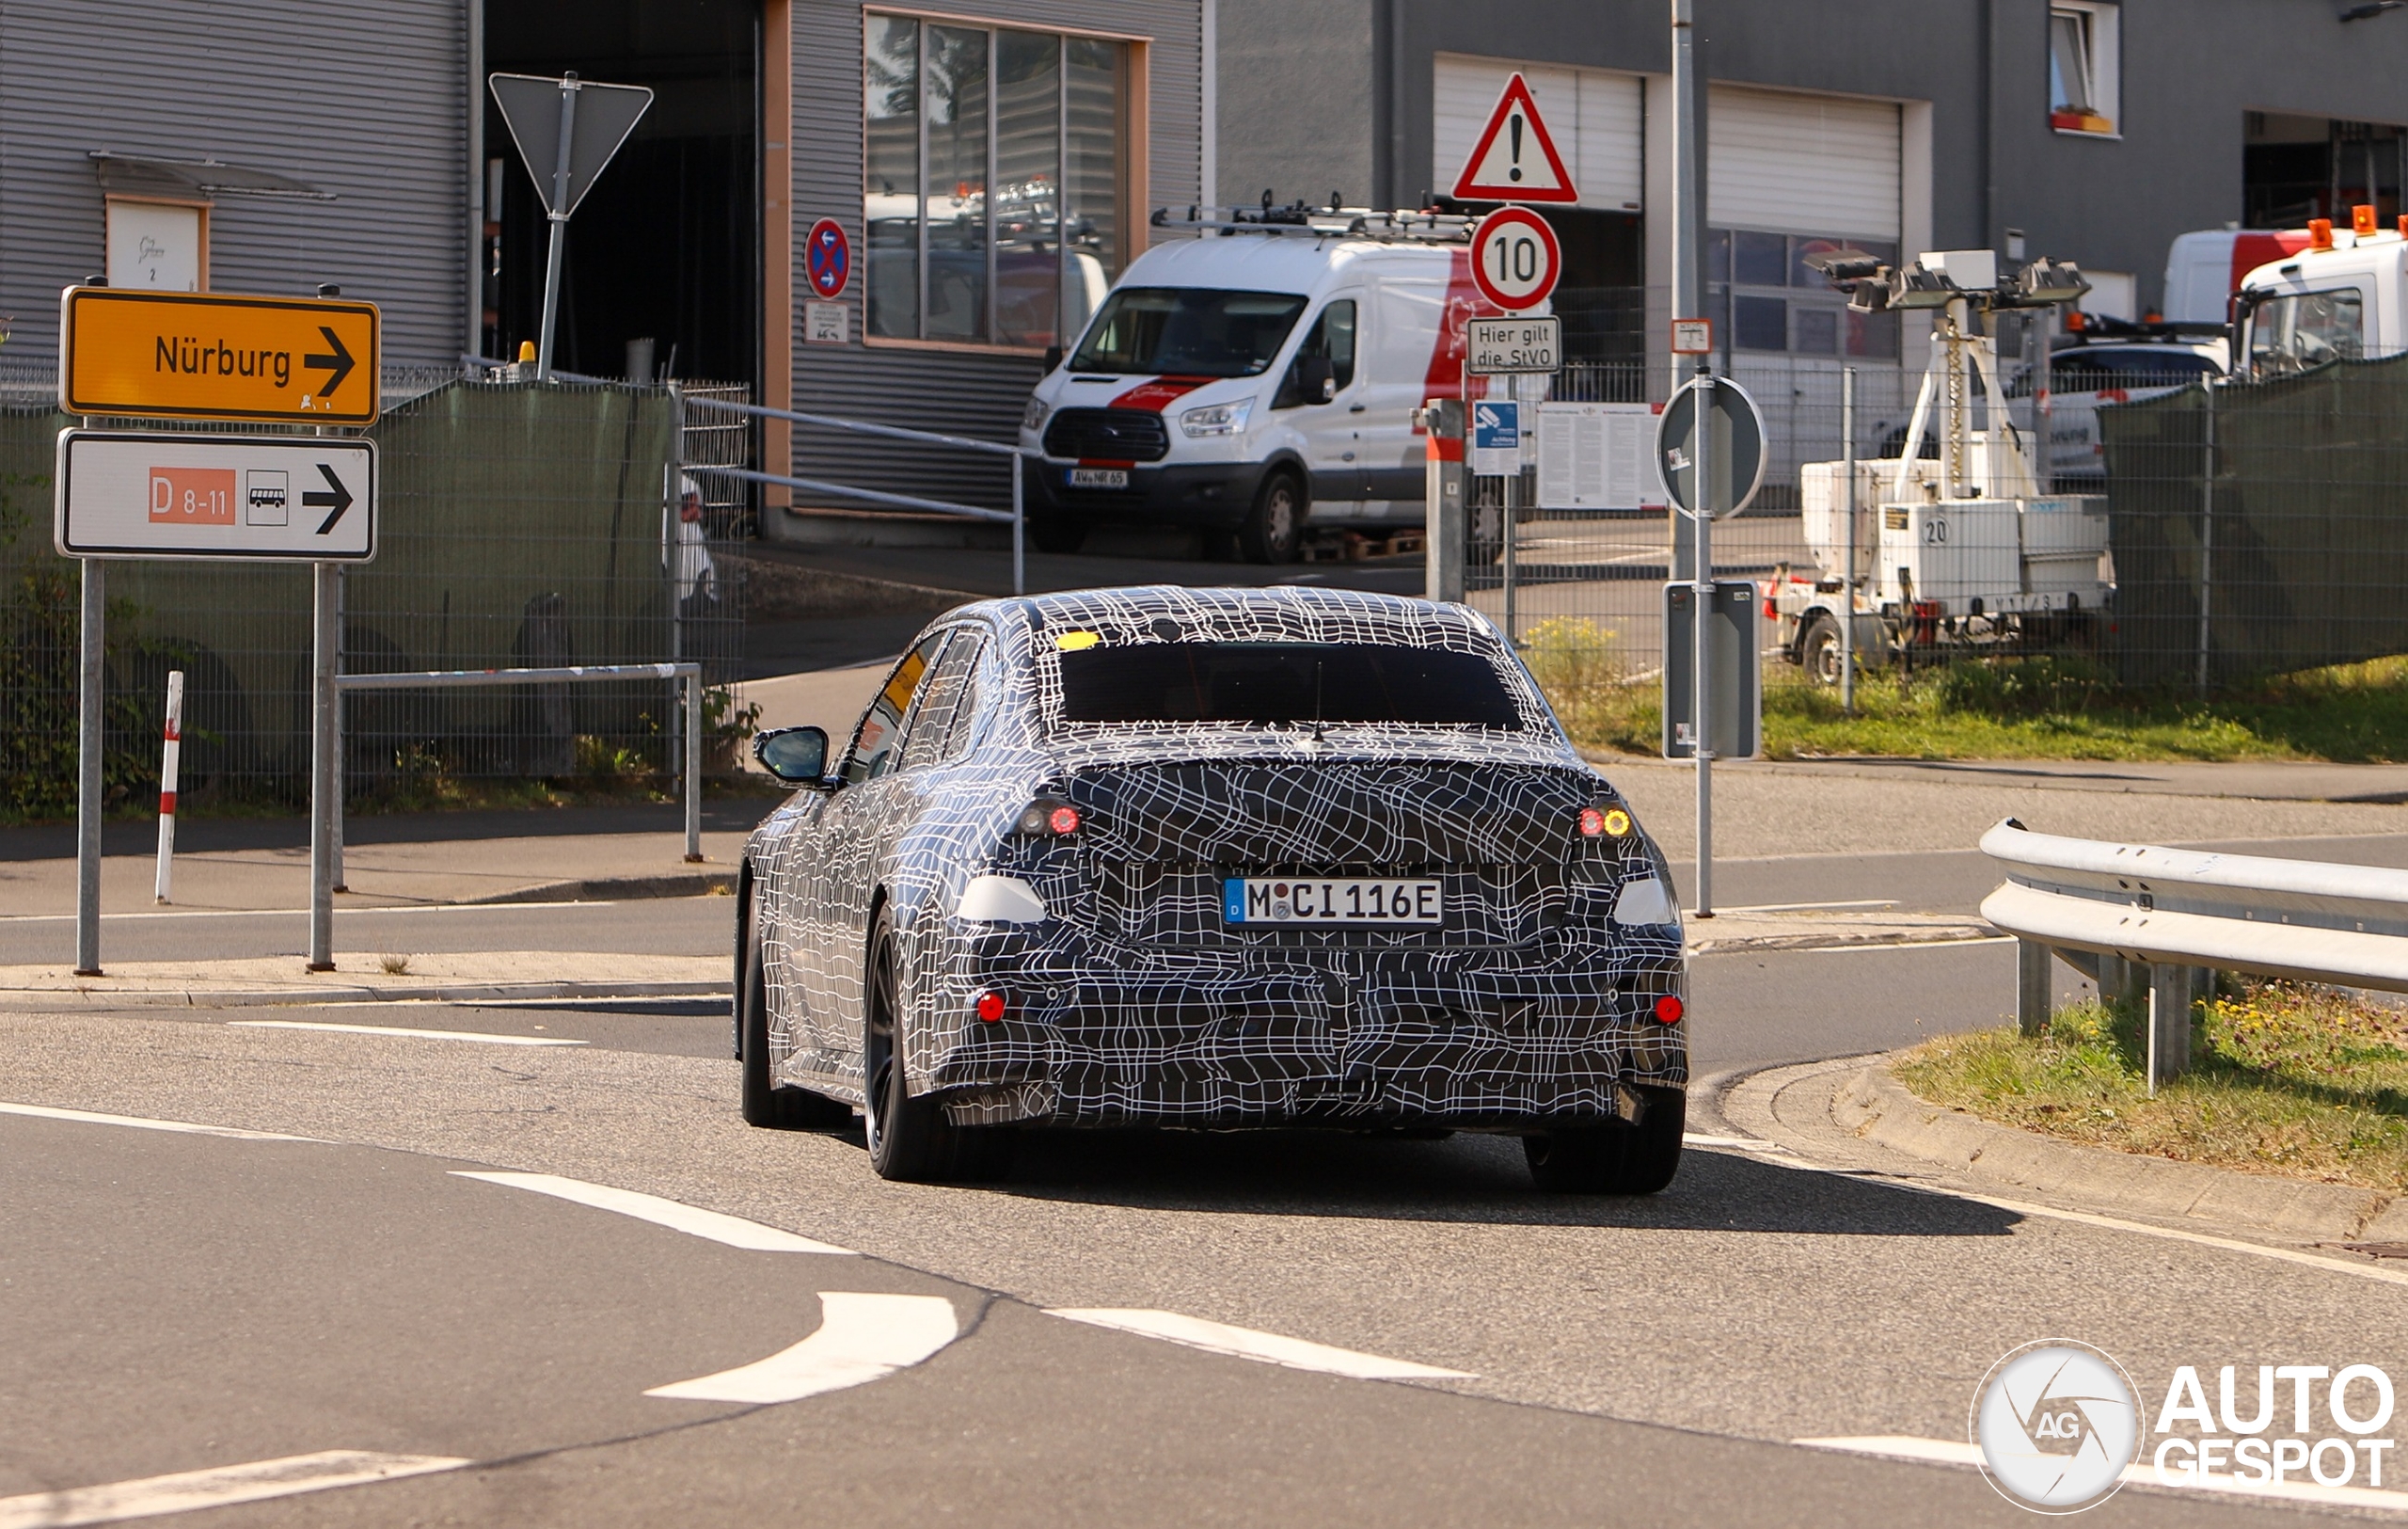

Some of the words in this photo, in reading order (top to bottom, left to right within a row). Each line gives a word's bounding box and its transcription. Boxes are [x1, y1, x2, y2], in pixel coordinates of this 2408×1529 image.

[1494, 237, 1536, 282] 10
[150, 267, 155, 281] 2
[1479, 326, 1514, 342] Hier
[1522, 325, 1548, 345] gilt
[155, 335, 291, 389] Nürburg
[1478, 350, 1502, 366] die
[1510, 348, 1551, 366] StVO
[1074, 471, 1087, 483] AW
[1093, 471, 1107, 484] NR
[151, 476, 173, 514] D
[183, 488, 226, 516] 8-11
[1925, 520, 1946, 543] 20
[1230, 905, 1240, 916] D
[1247, 884, 1270, 917] M
[1291, 884, 1337, 918] CI
[1346, 884, 1438, 919] 116E
